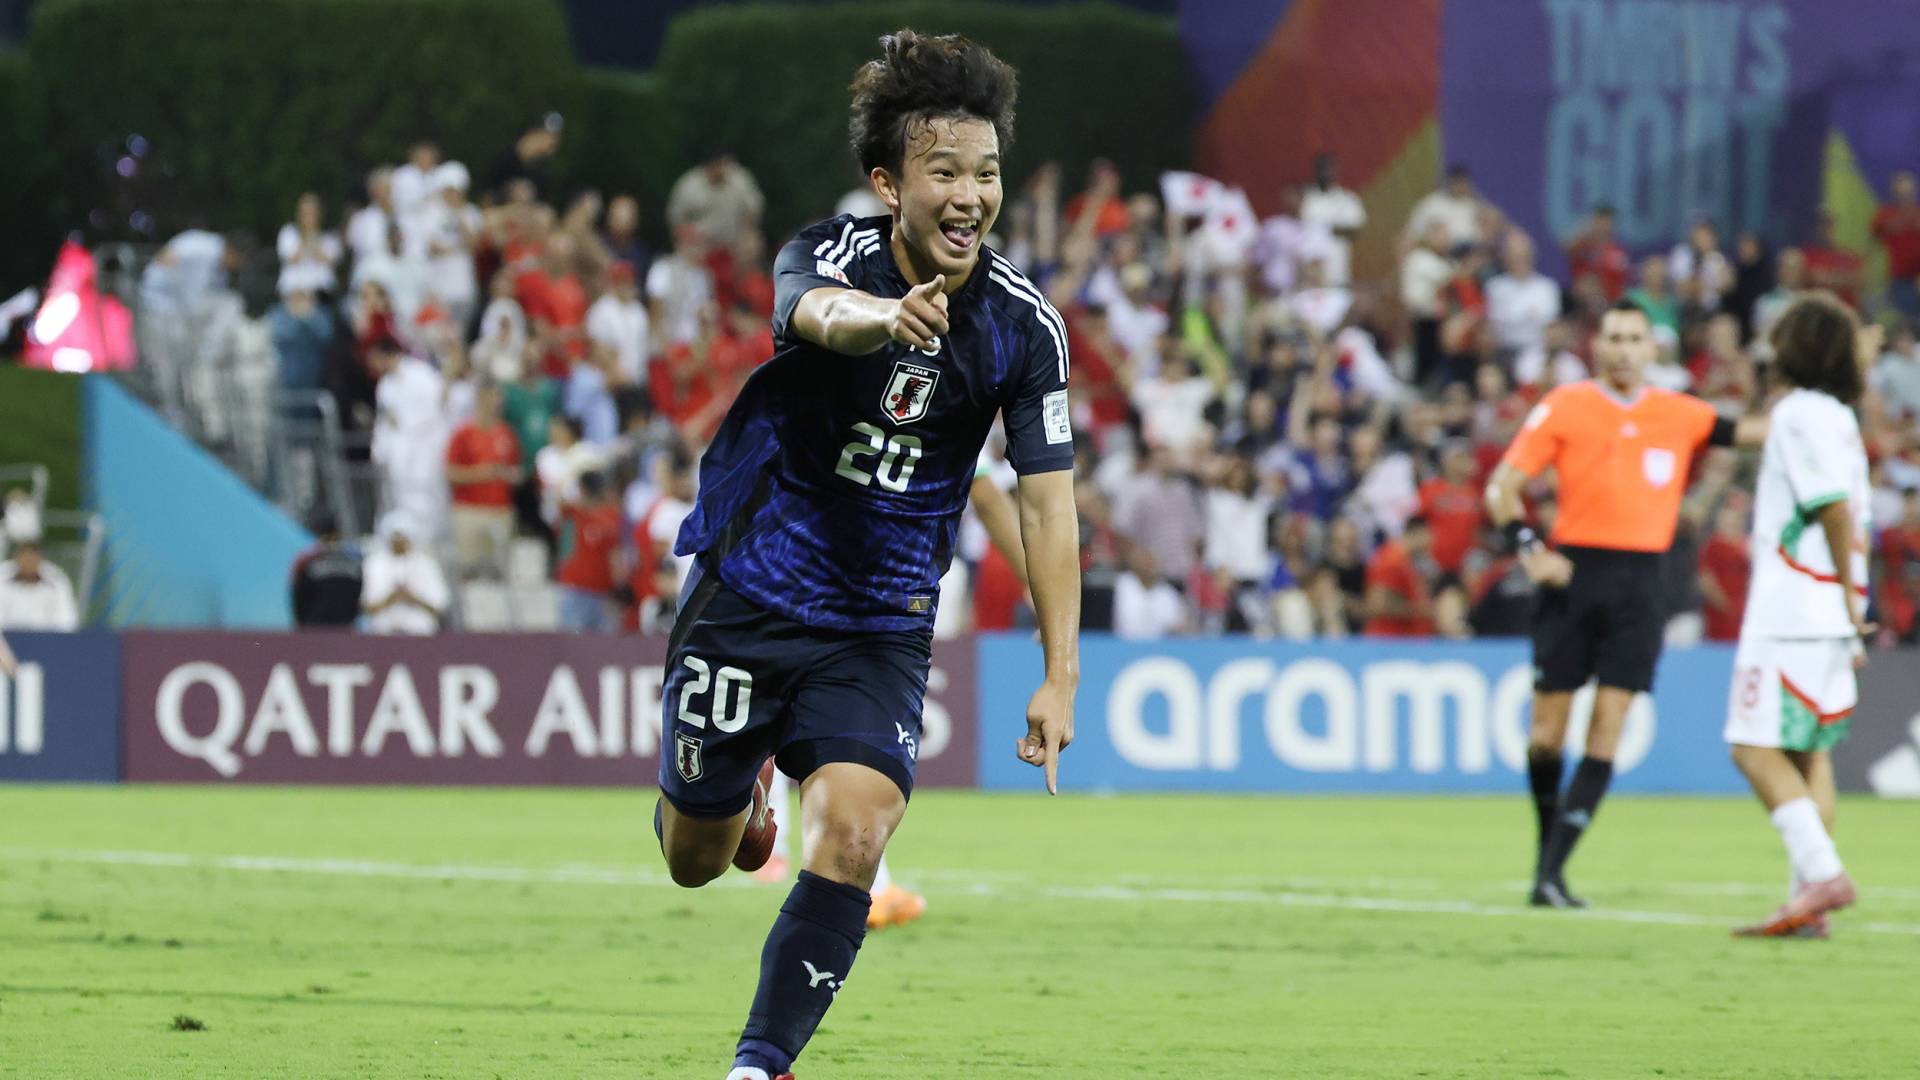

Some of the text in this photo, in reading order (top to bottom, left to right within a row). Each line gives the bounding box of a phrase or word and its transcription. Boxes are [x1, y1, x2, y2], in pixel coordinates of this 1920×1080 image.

[1545, 96, 1786, 246] GOAT
[905, 366, 929, 377] JAPAN
[834, 421, 923, 494] 20
[154, 663, 502, 777] QATAR
[678, 655, 752, 733] 20
[894, 720, 916, 761] Y-3
